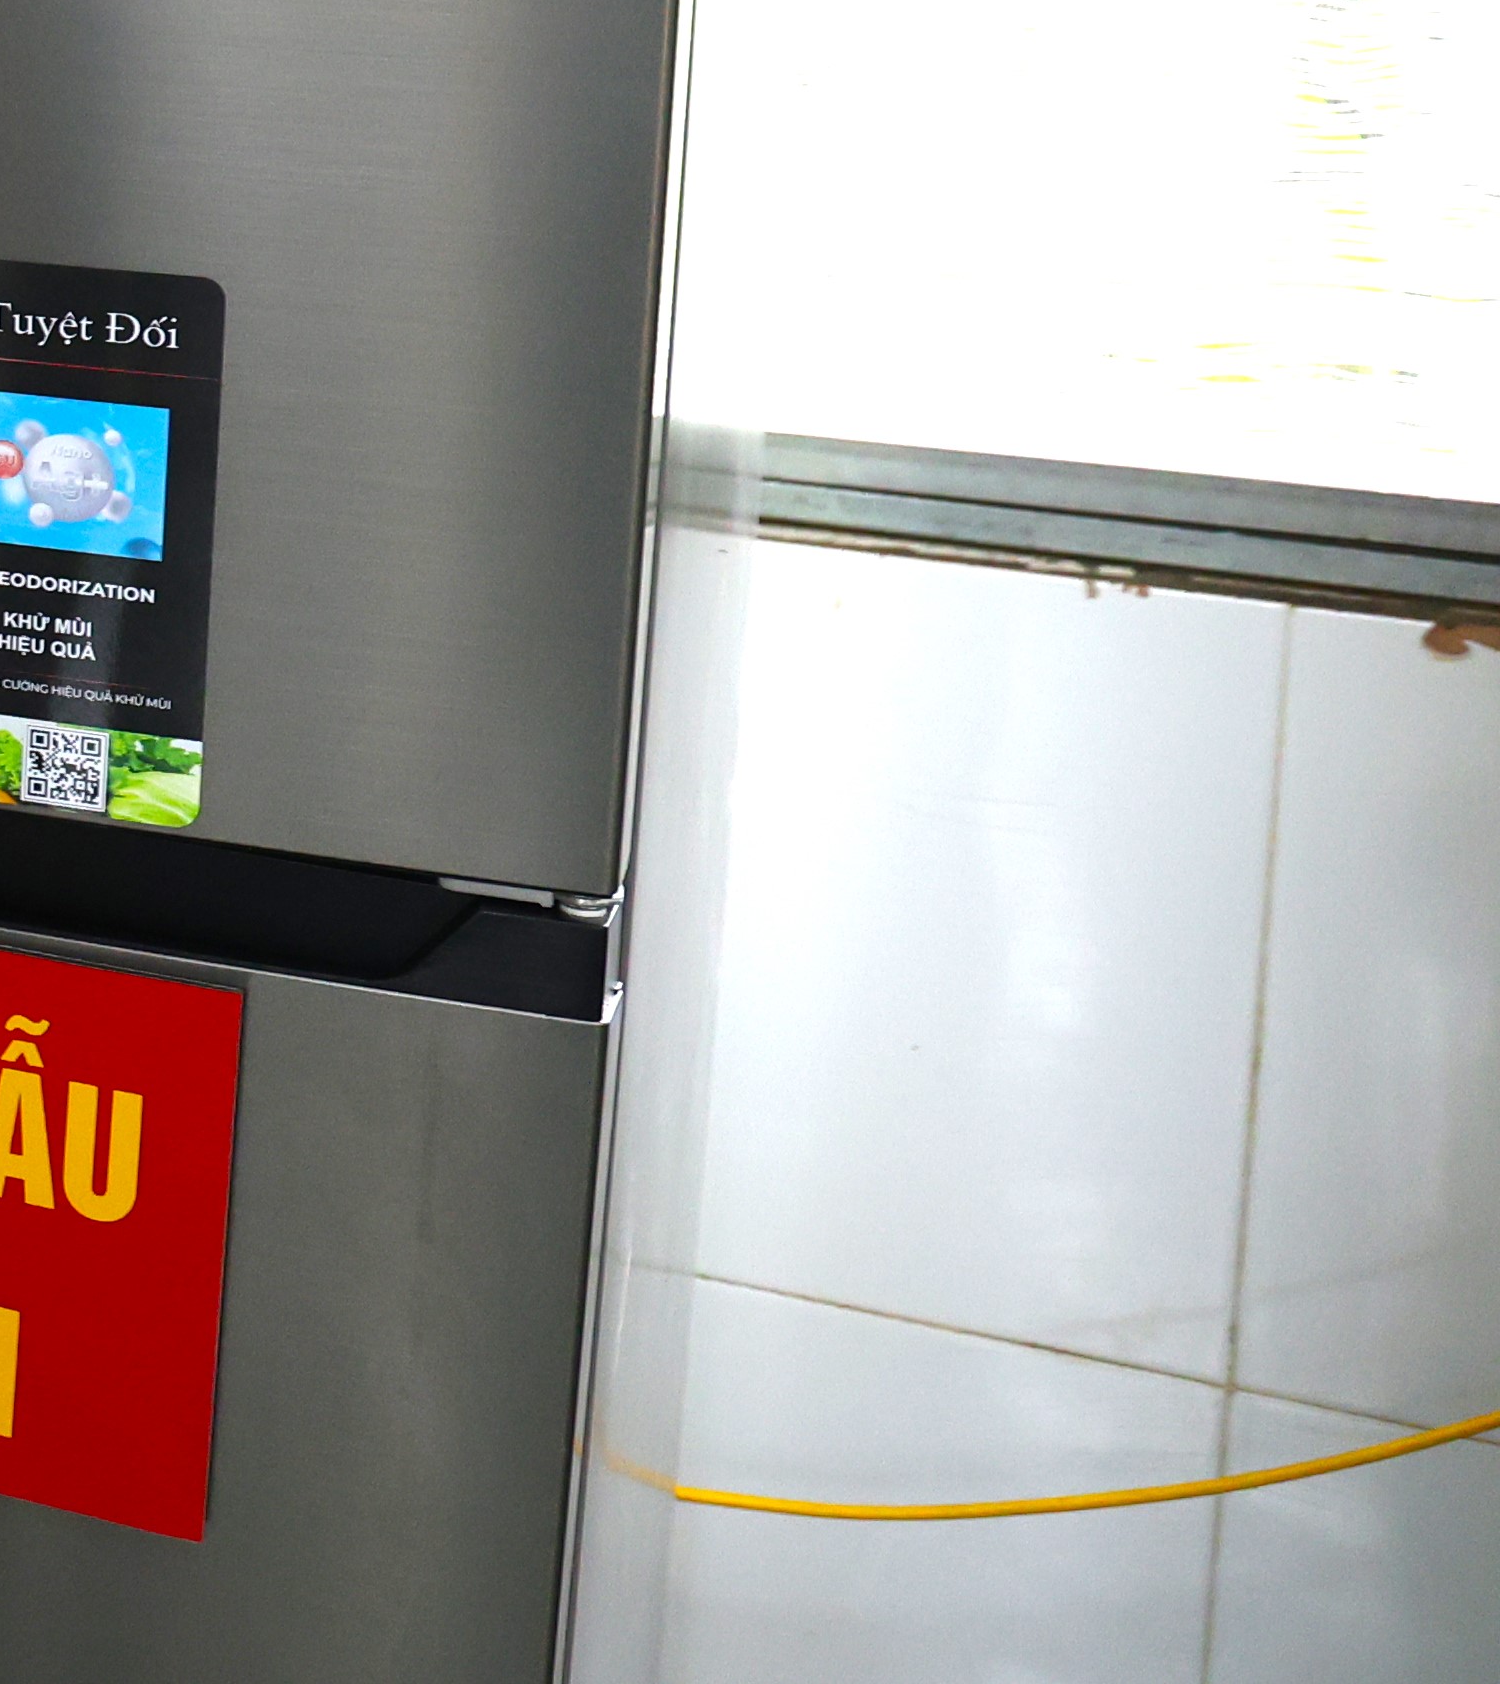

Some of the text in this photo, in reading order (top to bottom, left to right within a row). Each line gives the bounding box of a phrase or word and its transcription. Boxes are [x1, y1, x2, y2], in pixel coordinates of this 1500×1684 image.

[104, 311, 180, 350] Đối
[2, 611, 93, 639] KHỬ MÙI
[49, 640, 97, 663] QUẢ
